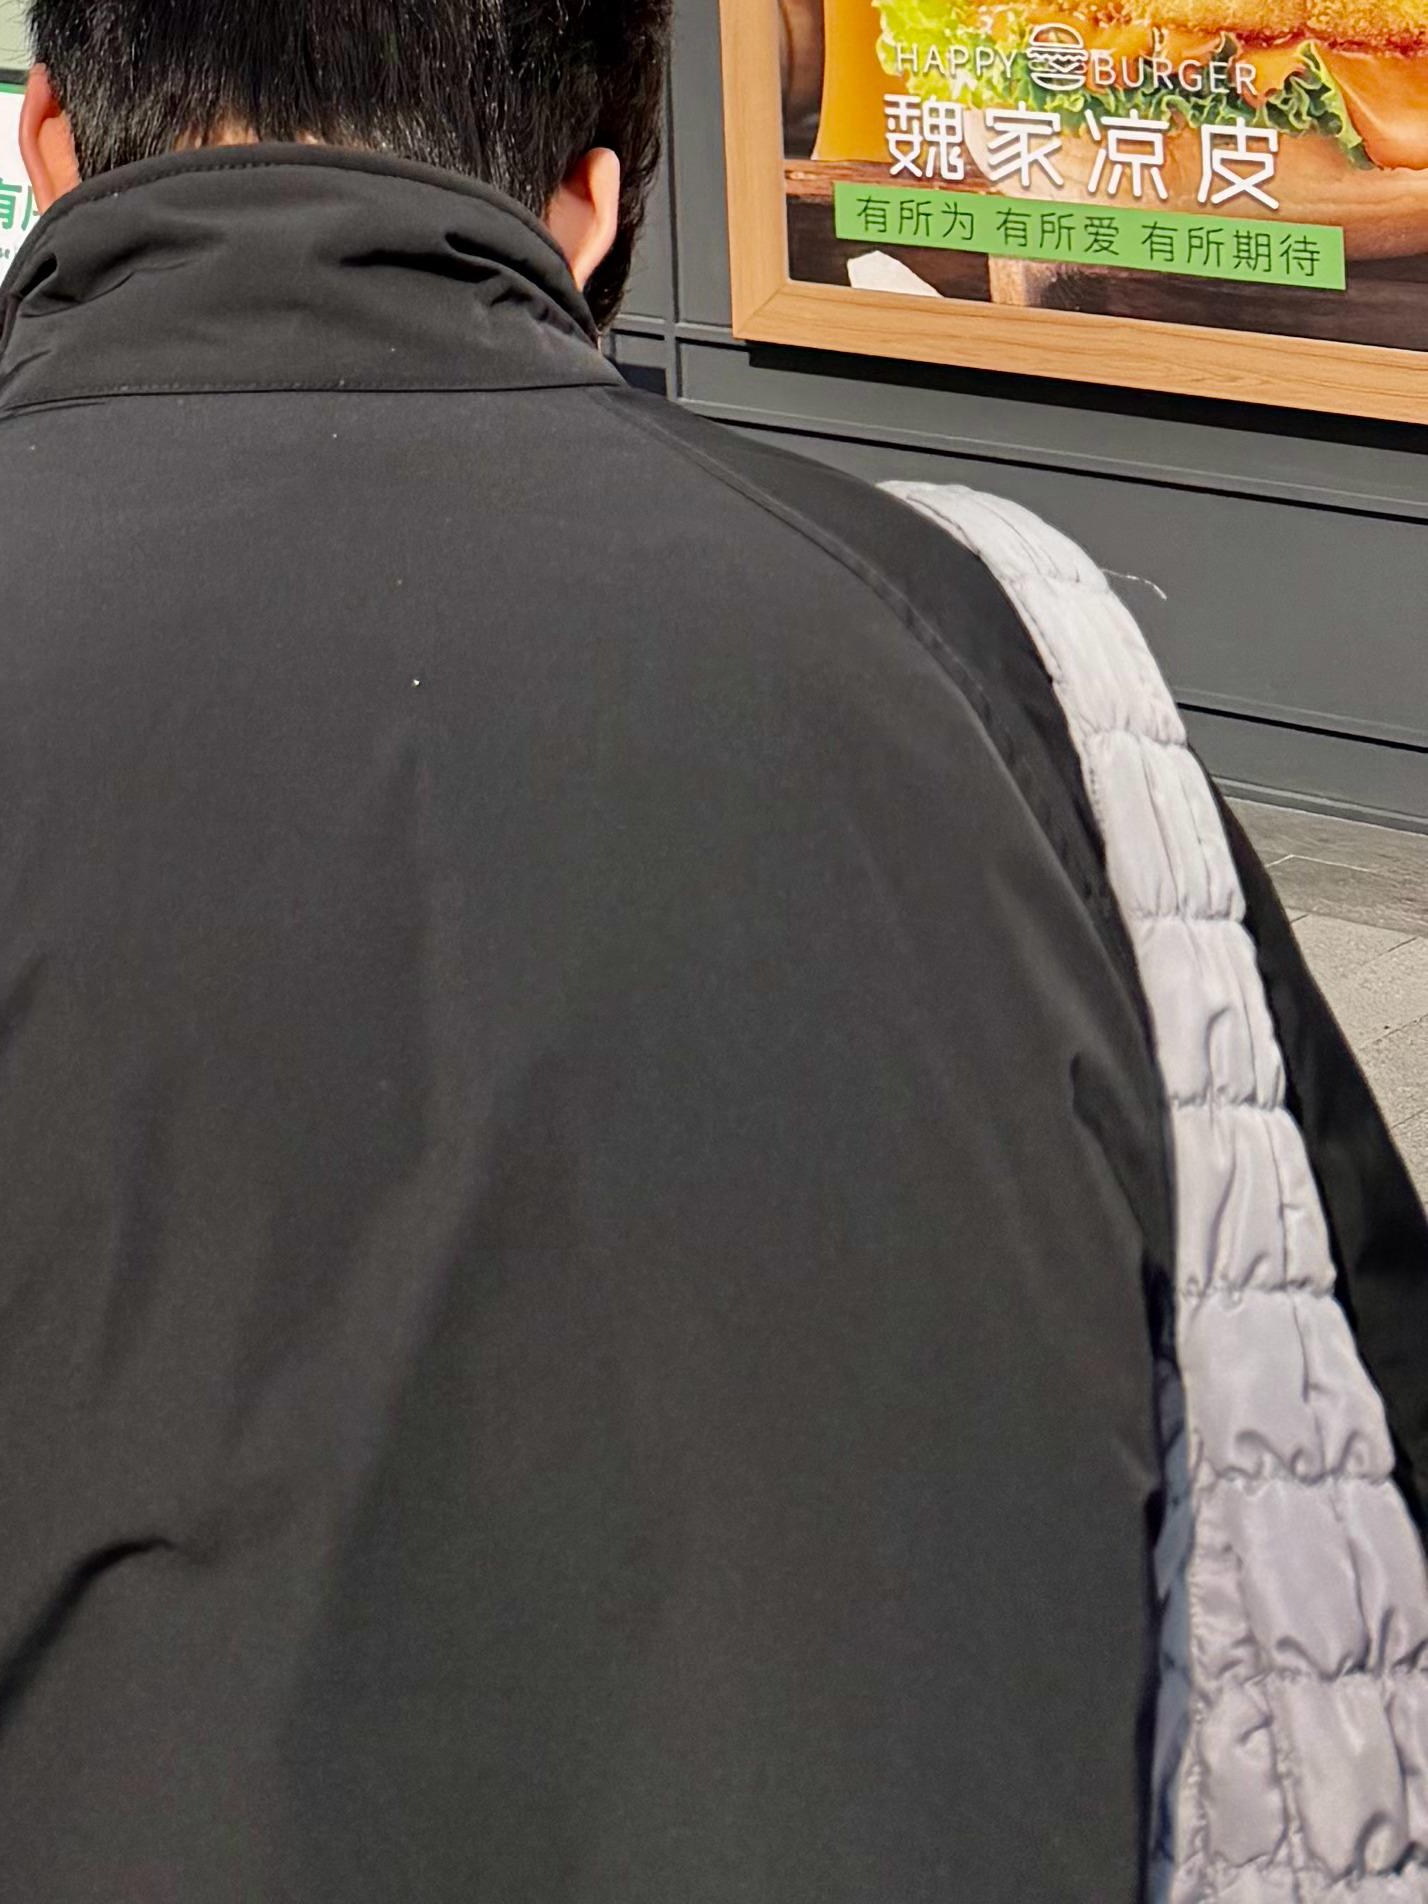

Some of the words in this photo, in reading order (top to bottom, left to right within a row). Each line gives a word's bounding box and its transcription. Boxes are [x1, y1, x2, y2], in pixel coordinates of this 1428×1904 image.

[895, 42, 1018, 80] HAPPY
[1092, 55, 1258, 95] BURGER
[883, 92, 1281, 211] 魏家凉皮
[855, 194, 976, 242] 有所为
[995, 206, 1122, 257] 有所爱
[1140, 220, 1322, 278] 有所期待
